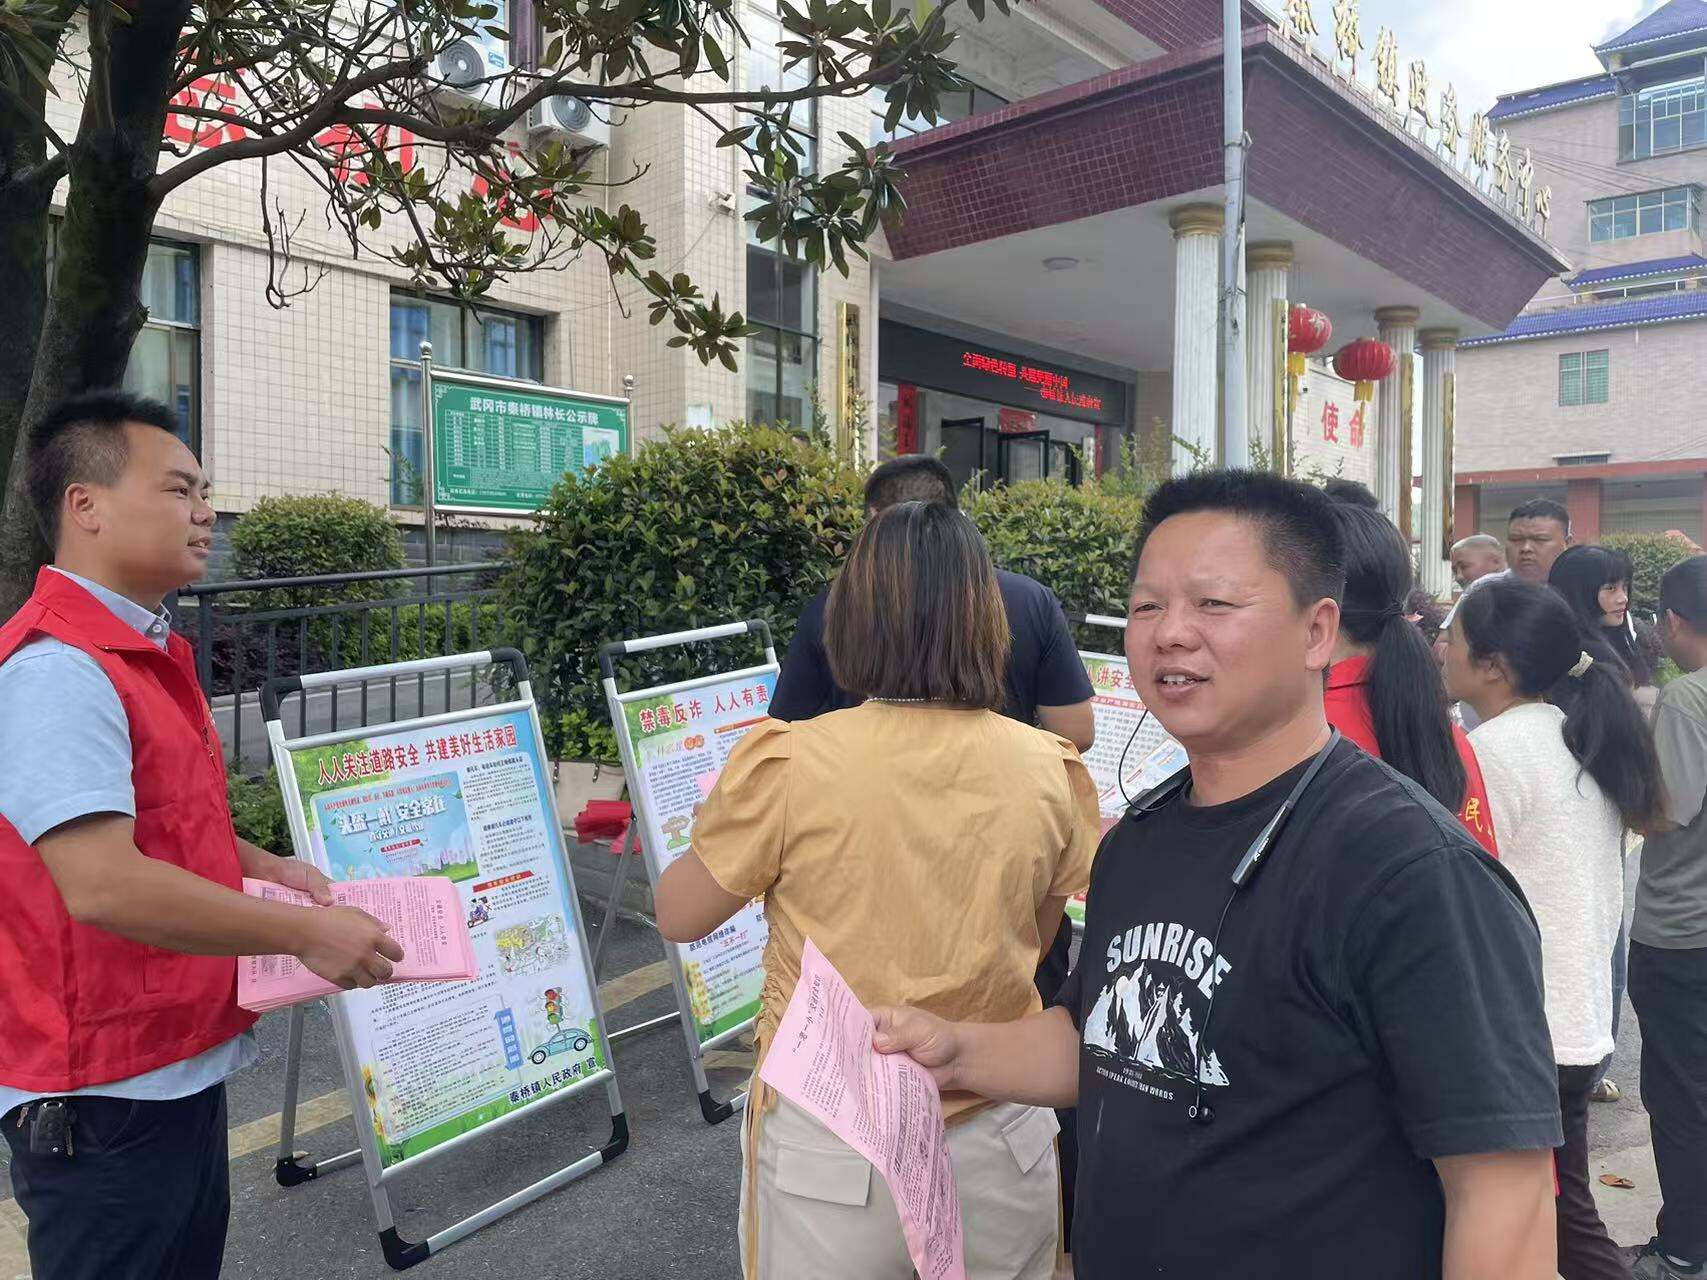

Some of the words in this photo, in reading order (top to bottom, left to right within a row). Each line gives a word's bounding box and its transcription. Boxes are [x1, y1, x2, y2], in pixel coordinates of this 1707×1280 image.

[469, 396, 599, 426] 武冈市秦桥镇林长公示牌
[639, 700, 703, 734] 禁毒反诈
[714, 685, 769, 715] 人人有责
[317, 743, 420, 786] 人人关注道路安全
[424, 724, 518, 764] 共建美好生活家园
[1106, 922, 1232, 1000] SUNRISE
[508, 1063, 582, 1105] 秦桥镇人民政府
[586, 1057, 596, 1071] 宣
